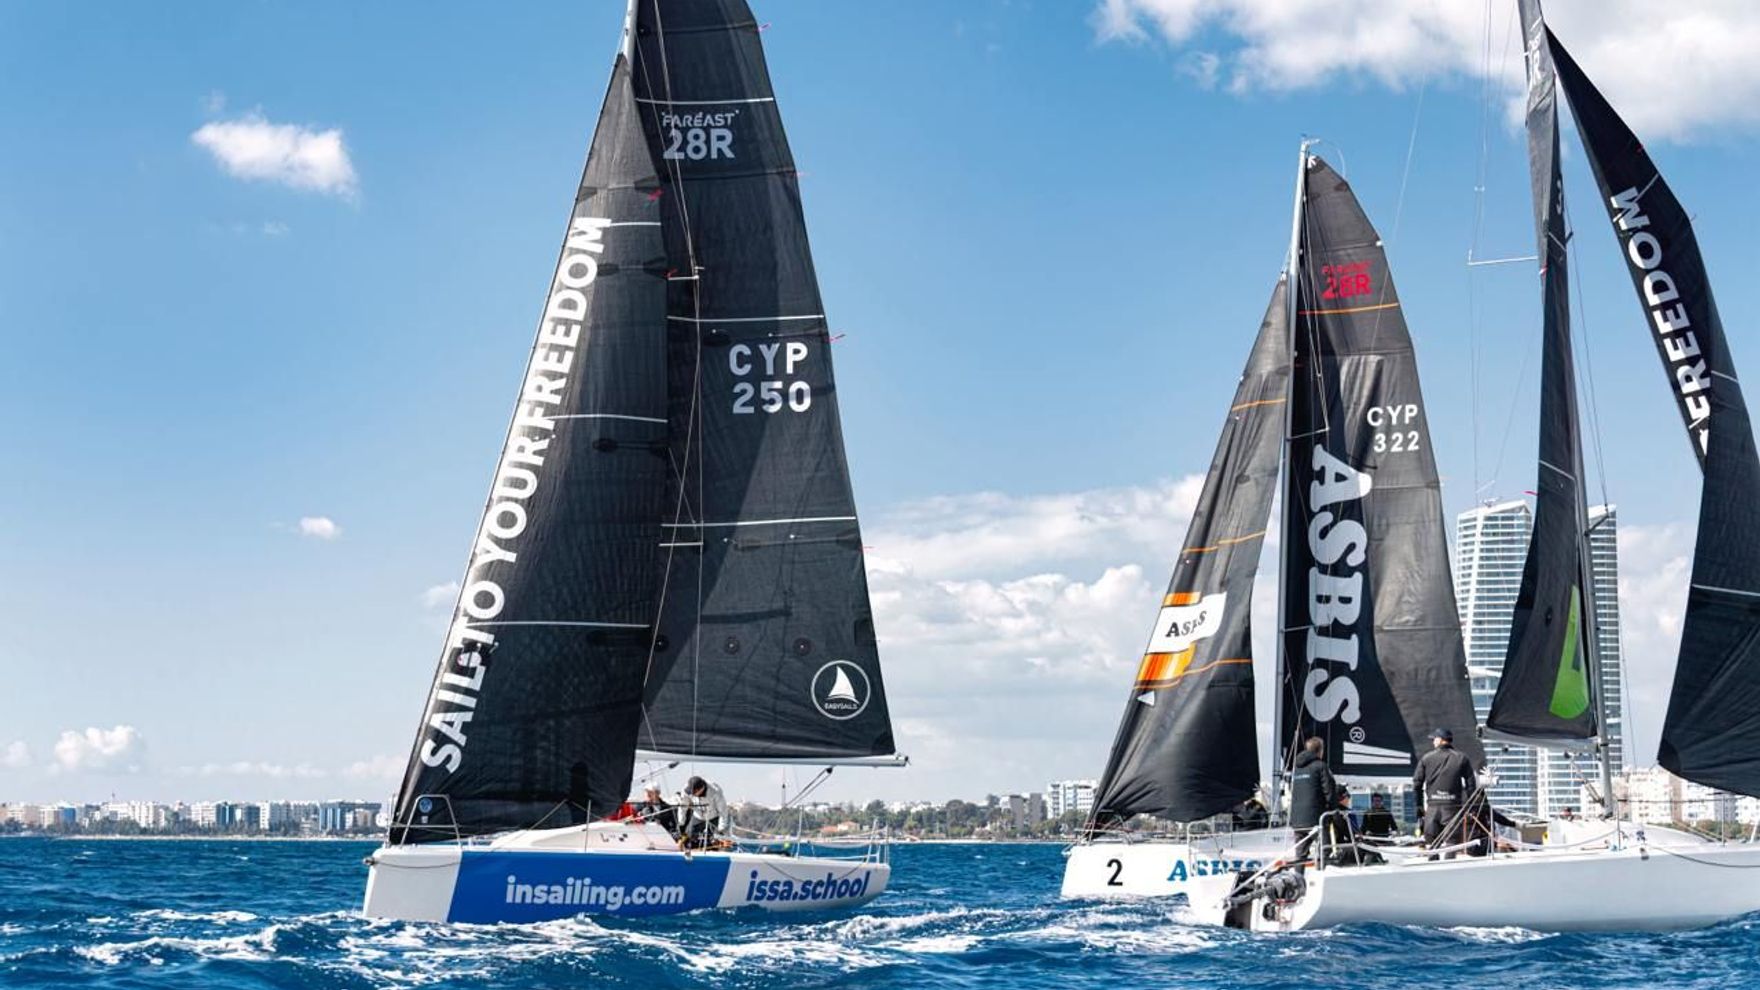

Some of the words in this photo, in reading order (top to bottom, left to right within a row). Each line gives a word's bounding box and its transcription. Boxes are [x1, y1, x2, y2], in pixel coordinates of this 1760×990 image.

[663, 128, 736, 160] 28R
[729, 342, 808, 376] CYP
[732, 381, 811, 414] 250
[1367, 404, 1418, 427] CYP
[1373, 430, 1419, 453] 322
[1304, 444, 1372, 724] ASBIS
[452, 581, 504, 648] TO
[421, 661, 487, 773] SAIL
[746, 870, 871, 902] issa.school
[1106, 858, 1123, 886] 2
[505, 875, 685, 910] insailing.com
